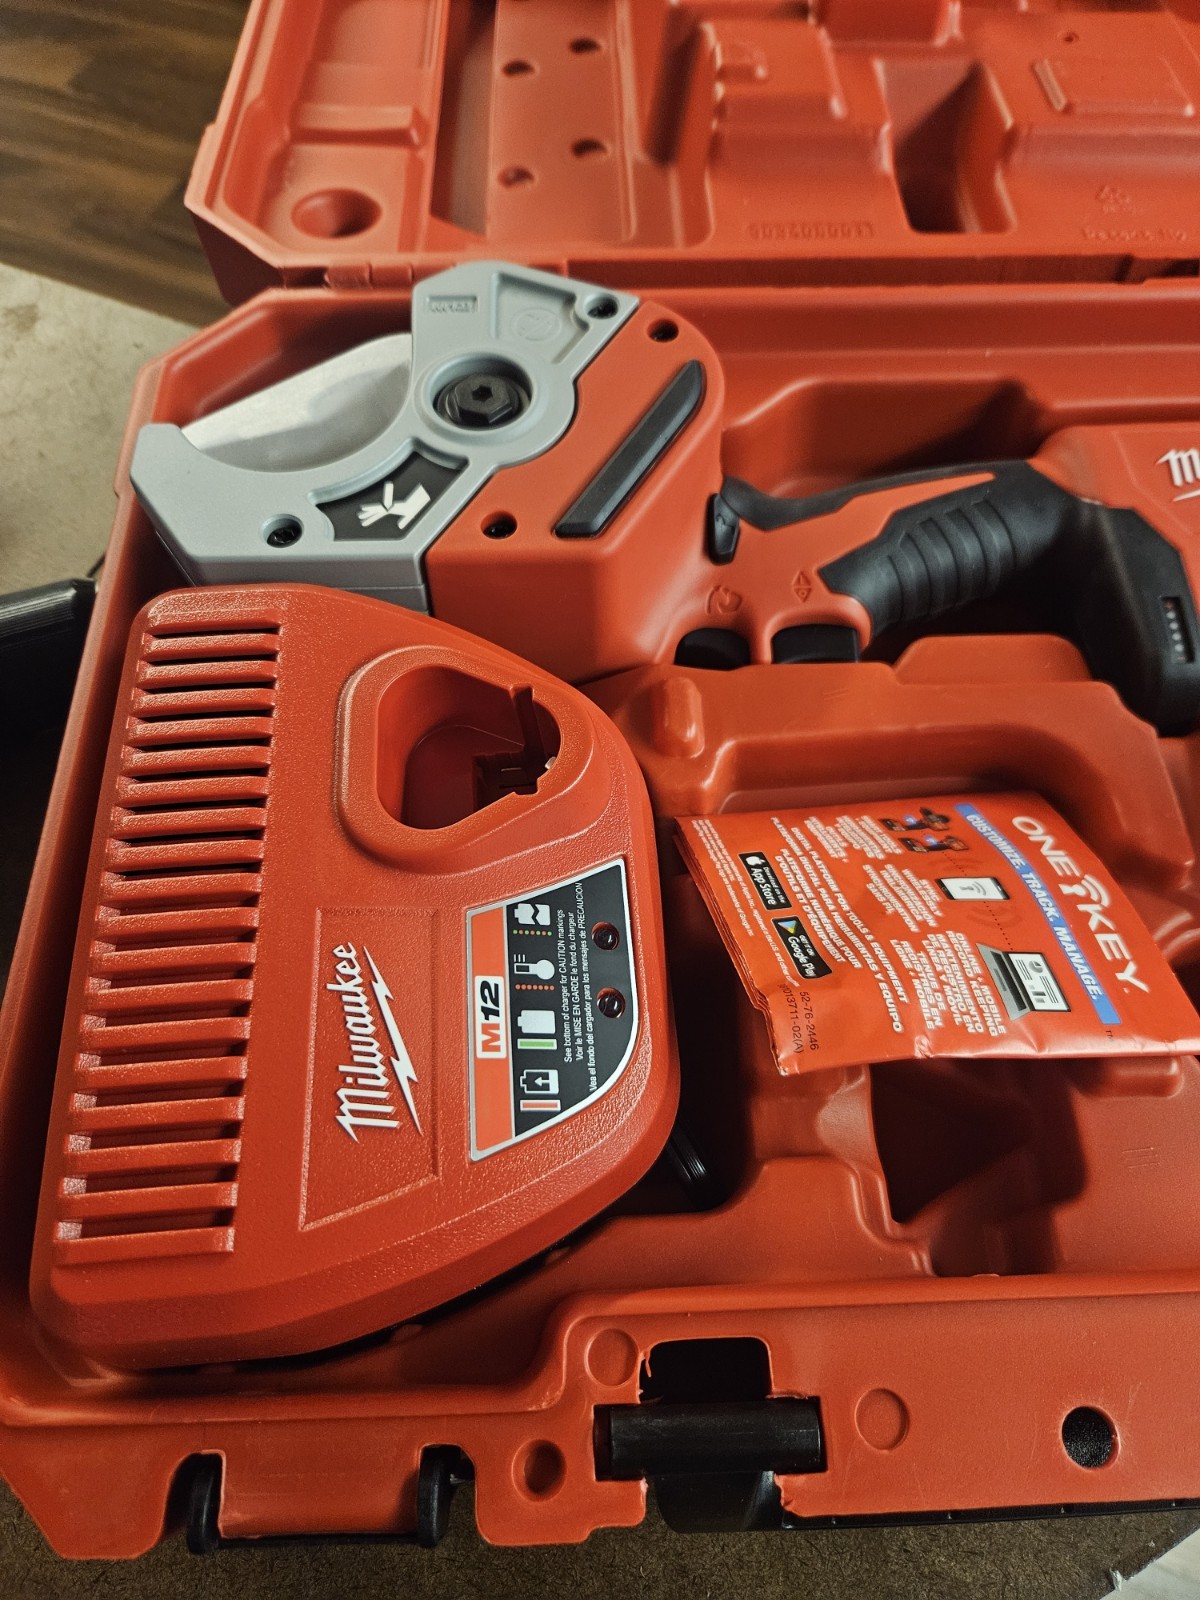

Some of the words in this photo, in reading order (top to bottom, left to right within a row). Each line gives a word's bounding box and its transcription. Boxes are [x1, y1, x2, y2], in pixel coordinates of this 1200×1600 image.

[771, 817, 803, 856] PLATAFORMA
[861, 816, 882, 832] SMART
[879, 833, 903, 854] TOOLS
[751, 868, 767, 883] App
[759, 884, 778, 904] Store
[763, 867, 778, 887] Download
[778, 895, 786, 903] the
[799, 856, 822, 886] DIGITAL
[575, 881, 586, 929] PRECAUCION
[817, 888, 836, 910] PARA
[862, 865, 918, 932] SYNCHRONISATION
[866, 883, 886, 901] SANS
[882, 902, 895, 912] FIL
[901, 869, 942, 916] WIRELESSLY
[919, 879, 940, 901] SYNC
[1009, 816, 1082, 878] ONE
[1075, 902, 1151, 995] KEY
[775, 856, 801, 892] D'OUTILS
[796, 894, 807, 903] ET
[803, 906, 845, 962] D'ÉQUIPEMENT
[780, 849, 815, 898] PLATEFORME
[810, 899, 844, 946] NUMÉRIQUE
[840, 947, 862, 968] POUR
[791, 827, 812, 850] DIGITAL
[809, 851, 839, 891] PLATFORM
[834, 893, 850, 910] FOR
[846, 912, 869, 933] TOOLS
[870, 942, 908, 1003] EQUIPMENT
[964, 814, 1026, 869] CUSTOMIZE.
[1021, 873, 1061, 921] TRACK.
[1053, 926, 1104, 999] MANAGE.
[556, 909, 565, 939] markings
[567, 911, 576, 941] chargeur
[578, 930, 587, 939] de
[557, 939, 567, 974] CAUTION
[569, 942, 576, 951] du
[580, 940, 589, 972] mensajes
[832, 912, 878, 970] HERRAMIENTAS
[570, 952, 578, 967] fond
[788, 937, 809, 963] Google
[803, 963, 816, 977] Play
[559, 975, 567, 984] for
[570, 975, 580, 1003] GARDE
[581, 973, 590, 983] los
[583, 984, 592, 1000] para
[873, 973, 884, 981] Y
[890, 939, 913, 969] LIGNE
[912, 979, 936, 1030] MOBILE
[900, 941, 936, 1004] REGISTRES
[930, 1007, 944, 1026] EN
[915, 951, 939, 989] TENUE
[933, 992, 947, 1011] DE
[927, 934, 939, 947] DE
[936, 950, 967, 1011] REGISTRO
[962, 1015, 976, 1033] EN
[936, 934, 985, 1032] MANTENIMIENTO
[938, 974, 949, 983] Y
[946, 931, 974, 977] RECORD
[969, 981, 999, 1036] KEEPING
[955, 933, 981, 973] ONLINE
[980, 985, 1007, 1034] MOBILE
[561, 985, 570, 1012] charger
[572, 1004, 581, 1016] EN
[878, 982, 904, 1032] EQUIPO
[480, 980, 502, 1053] M12
[561, 1012, 570, 1020] of
[573, 1017, 582, 1036] MISE
[584, 1001, 594, 1032] cargador
[800, 992, 819, 1050] 52-76-2446
[326, 942, 401, 1143] Milwaukee
[563, 1021, 571, 1046] bottom
[585, 1033, 594, 1045] del
[564, 1047, 573, 1063] See
[575, 1045, 584, 1061] Voir
[587, 1045, 595, 1067] fondo
[588, 1067, 596, 1075] el
[589, 1076, 597, 1091] Vea
